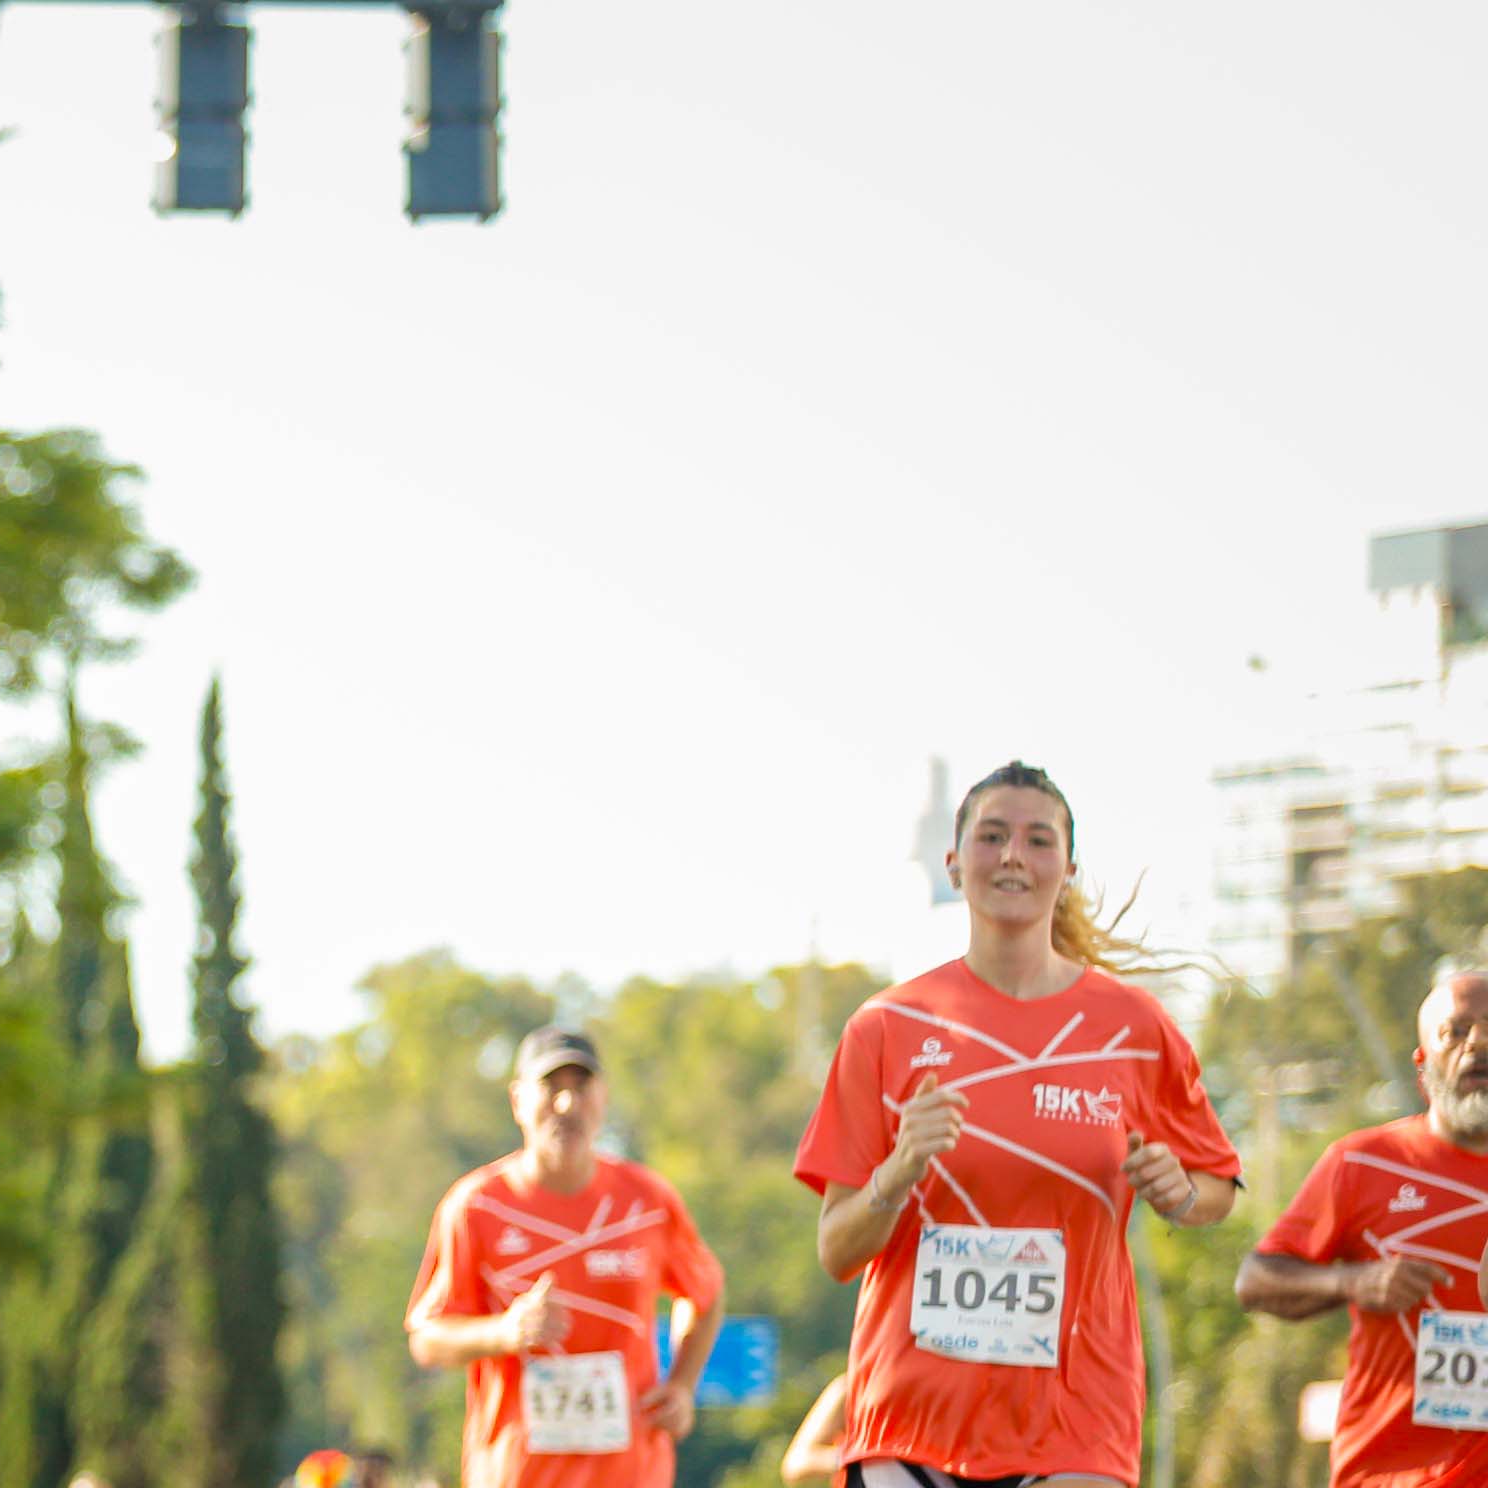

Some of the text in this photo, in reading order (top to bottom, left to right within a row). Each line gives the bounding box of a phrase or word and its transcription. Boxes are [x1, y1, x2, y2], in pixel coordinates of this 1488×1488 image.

[1032, 1082, 1082, 1115] 15K
[935, 1237, 970, 1257] 15K
[920, 1267, 1057, 1314] 1045
[1422, 1349, 1488, 1388] 20
